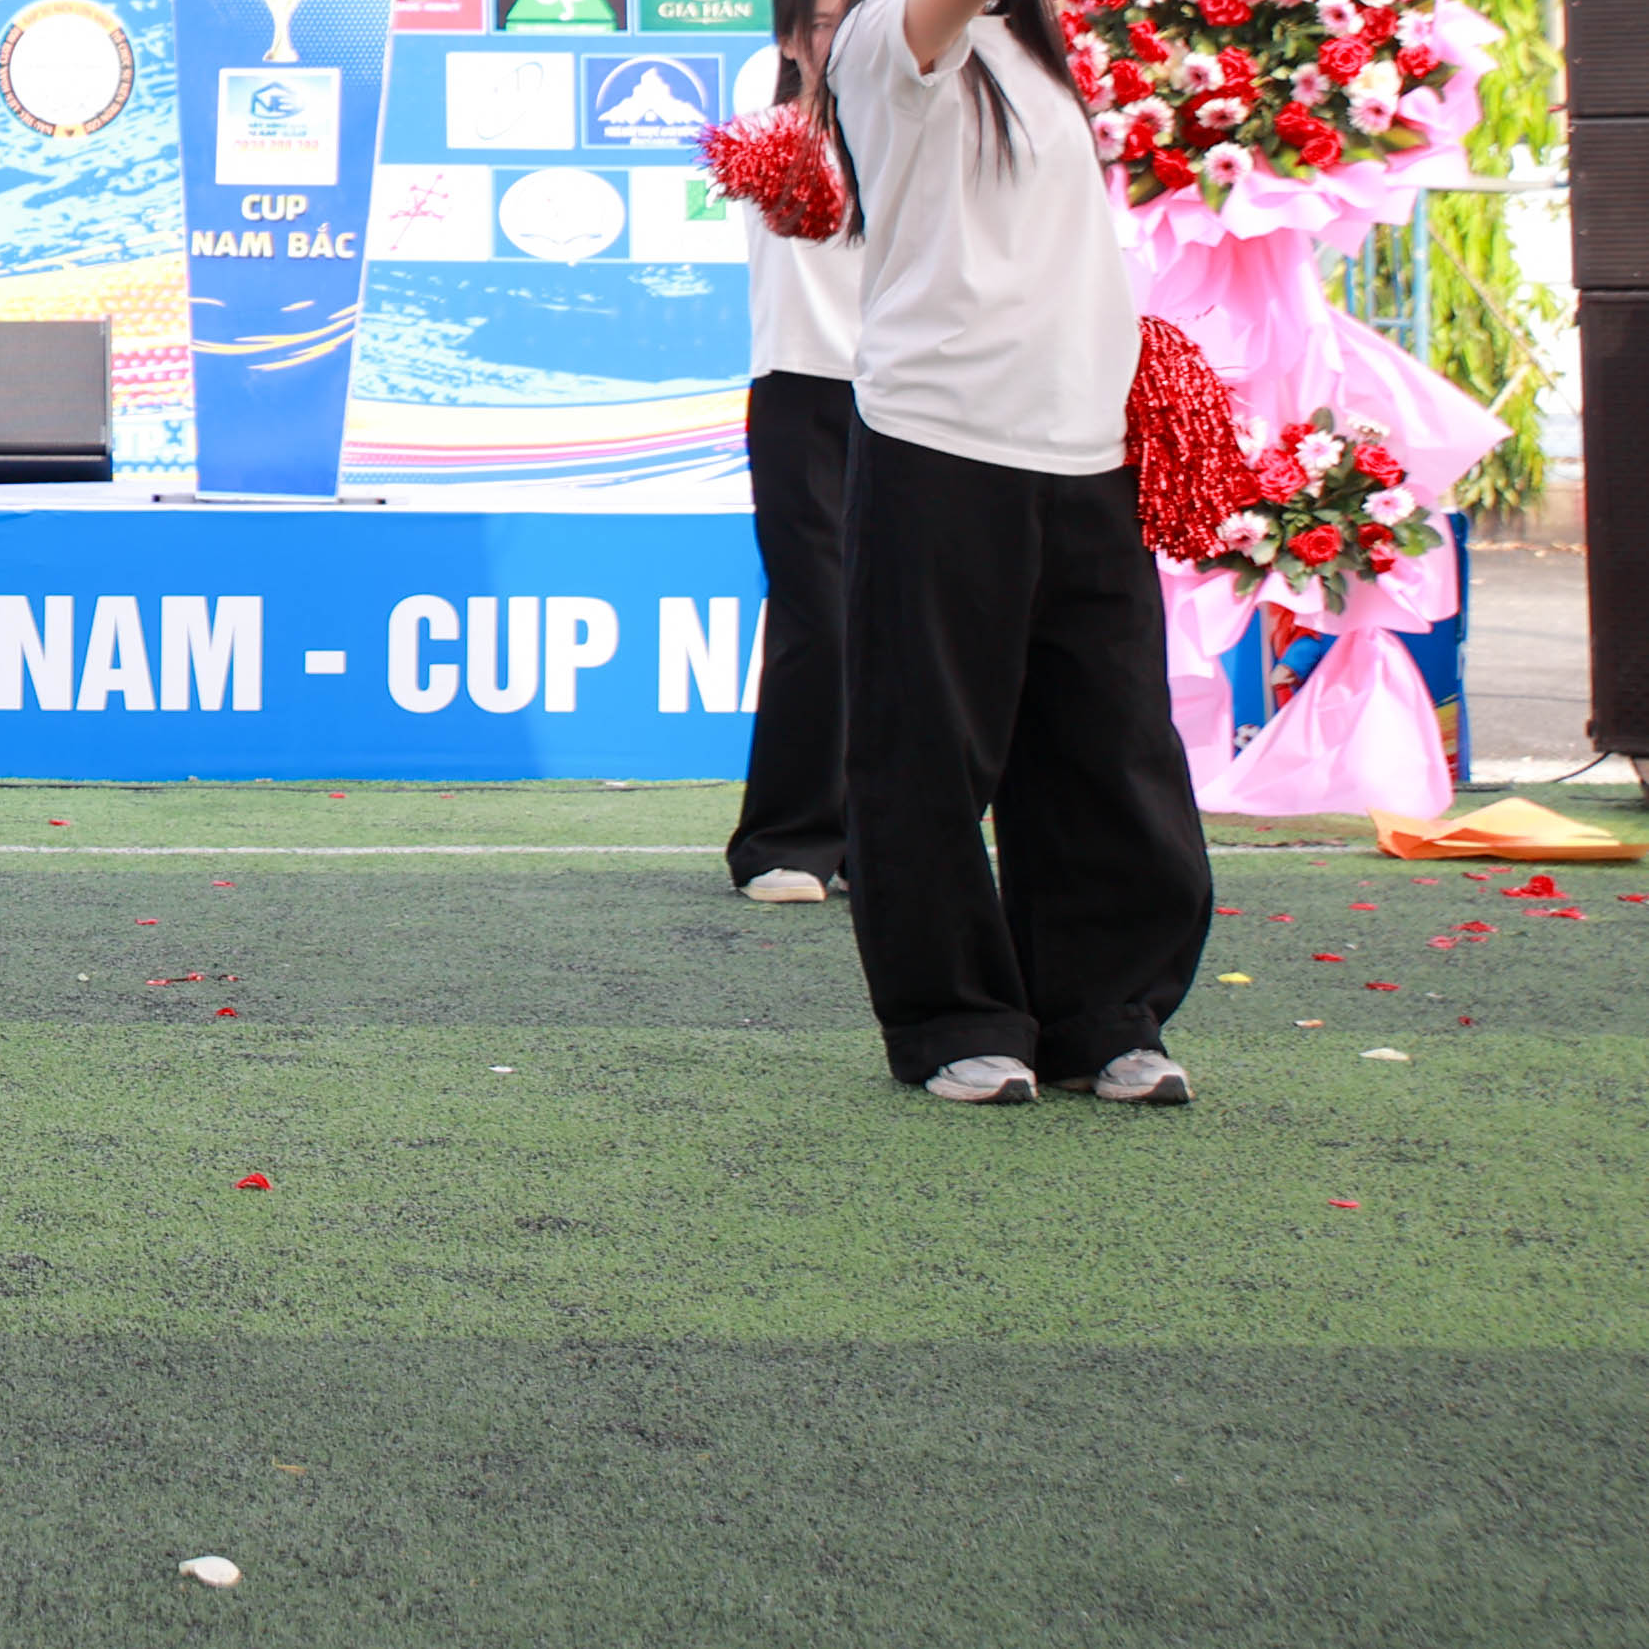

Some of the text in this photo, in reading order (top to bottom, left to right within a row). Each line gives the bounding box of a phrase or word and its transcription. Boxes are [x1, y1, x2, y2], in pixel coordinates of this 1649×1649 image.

[657, 1, 699, 19] GIA
[241, 193, 309, 221] CUP
[190, 230, 275, 259] NAM
[387, 594, 619, 714] CUP
